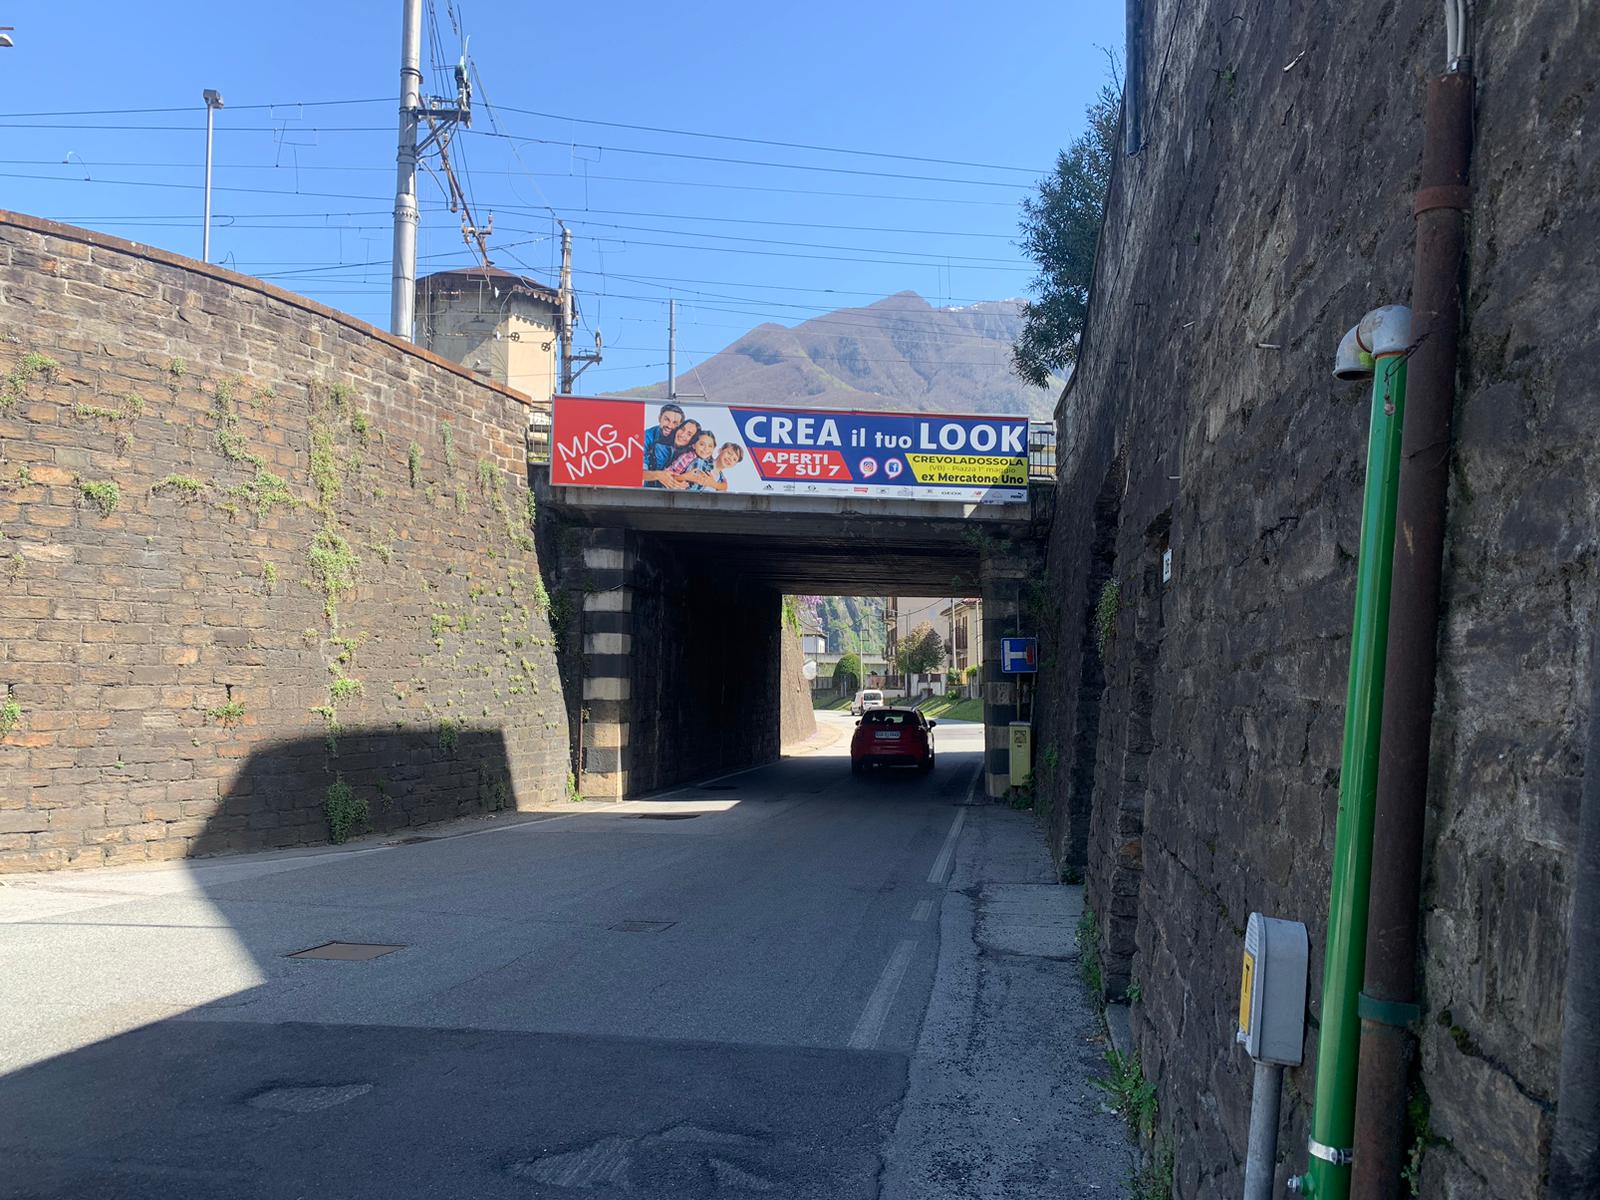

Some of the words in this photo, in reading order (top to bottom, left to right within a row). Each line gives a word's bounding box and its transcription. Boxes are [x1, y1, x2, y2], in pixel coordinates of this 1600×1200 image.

[744, 416, 842, 446] CREA
[851, 428, 866, 447] il
[875, 431, 912, 448] tuo
[920, 423, 1024, 452] LOOK
[557, 424, 618, 461] MAG
[762, 452, 828, 464] APERTI
[912, 455, 1024, 466] CREVOLADOSSOLA
[775, 464, 789, 475] 7
[795, 465, 821, 476] SU
[828, 465, 841, 477] 7
[938, 473, 998, 484] Mercatone
[1001, 475, 1024, 484] Uno
